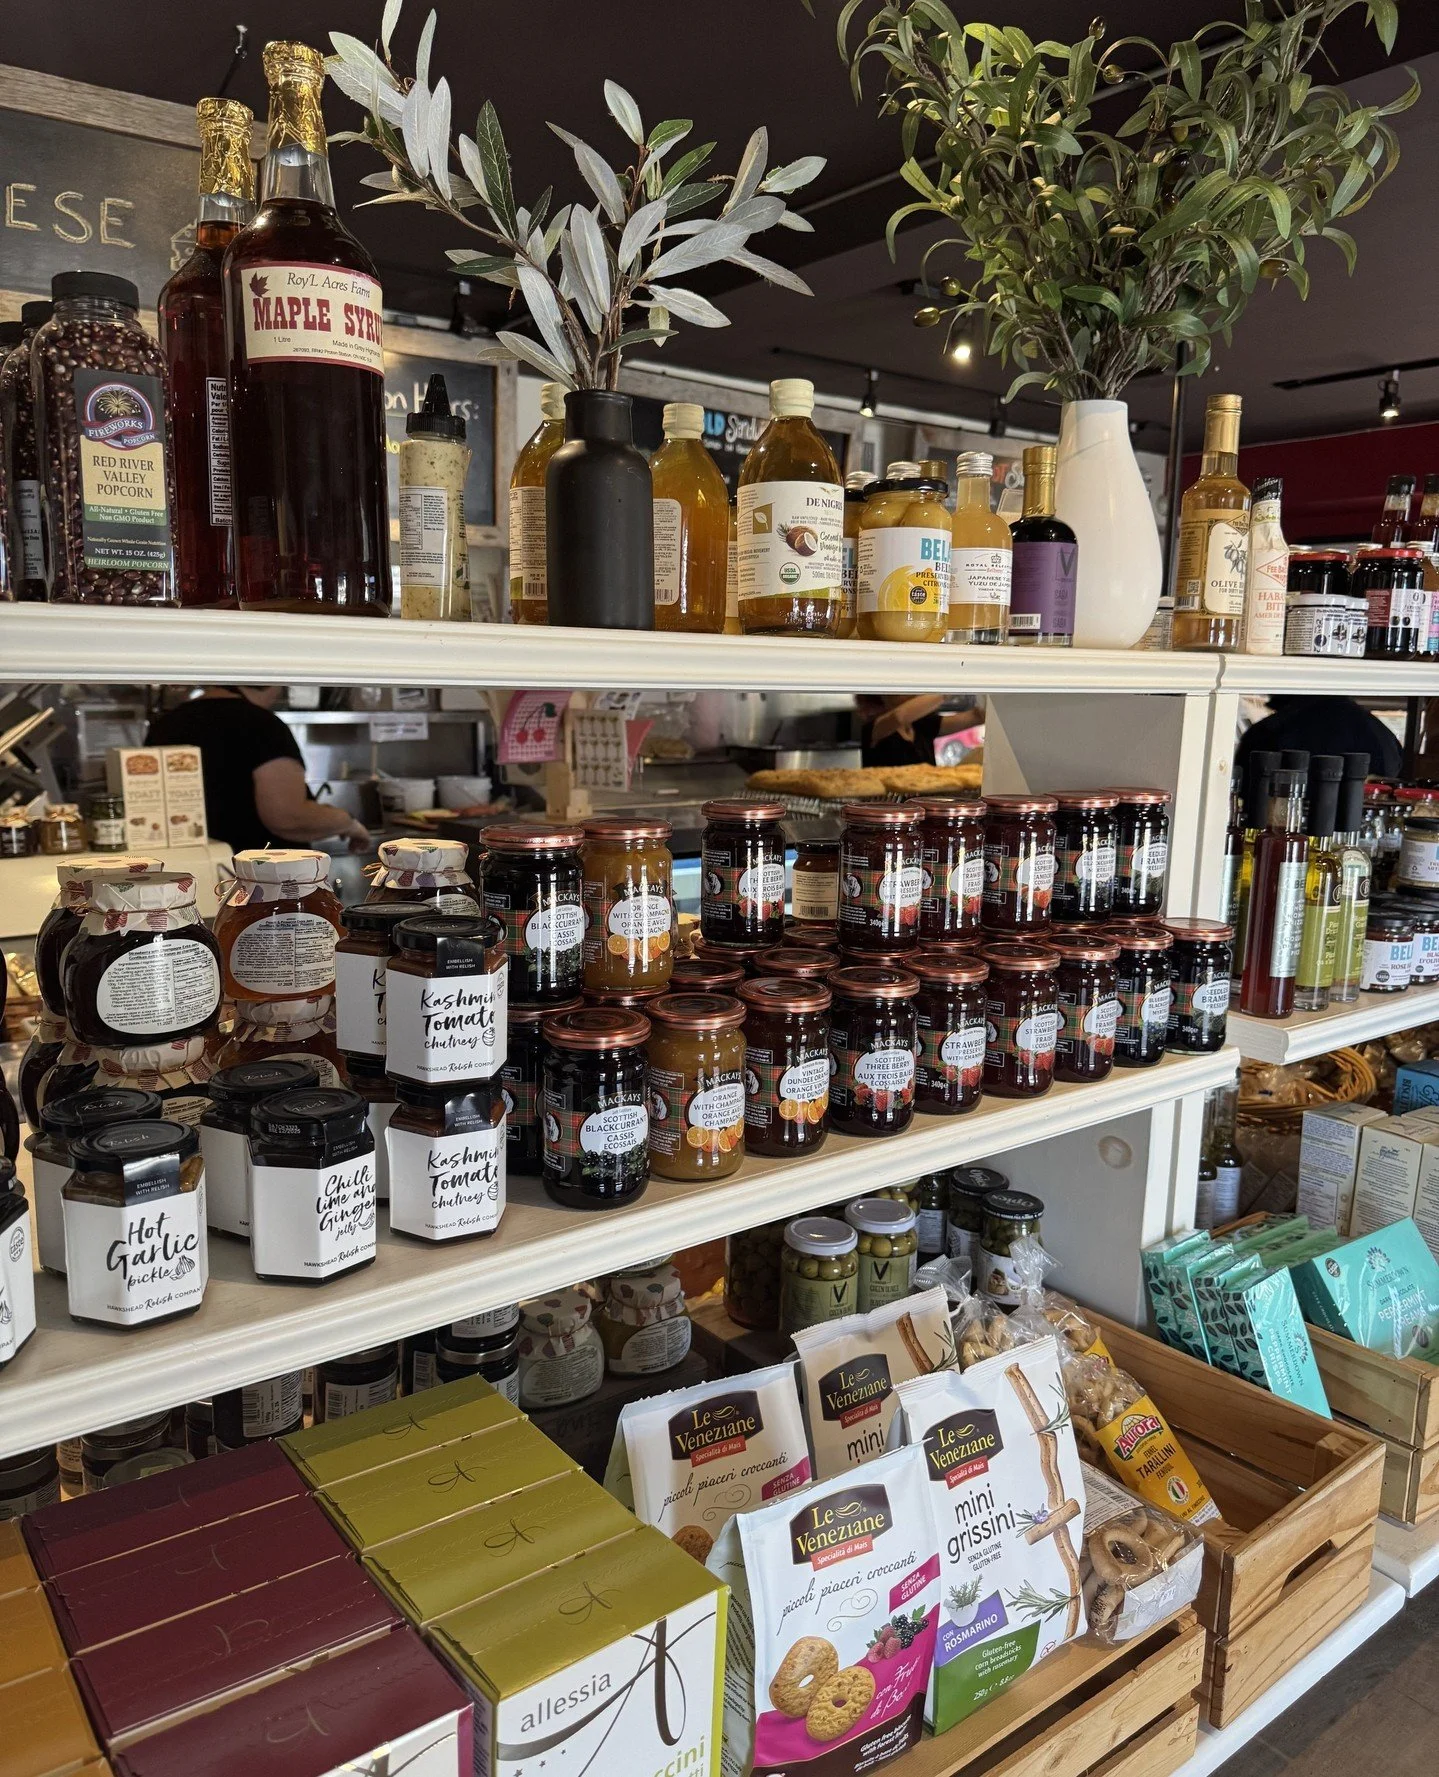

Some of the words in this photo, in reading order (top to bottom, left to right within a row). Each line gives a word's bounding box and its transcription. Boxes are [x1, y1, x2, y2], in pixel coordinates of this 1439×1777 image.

[322, 276, 348, 291] Acres
[253, 297, 331, 332] MAPLE
[88, 420, 143, 437] FIREWORKS
[123, 433, 155, 444] POPCORN
[93, 455, 116, 468] RED
[120, 458, 155, 471] RIVER
[103, 470, 146, 484] VALLEY
[97, 484, 153, 498] POPCORN
[806, 497, 820, 507] DE
[89, 506, 122, 514] All-Natural
[151, 510, 163, 518] Free
[132, 516, 155, 524] Product
[95, 547, 110, 555] NET
[88, 558, 130, 568] HEIRLOOM
[132, 560, 169, 569] POPCORN
[1266, 565, 1277, 573] FEE
[1211, 580, 1237, 589] OLIVE
[424, 1034, 480, 1050] chutney
[870, 1039, 909, 1050] MACKAYS
[416, 1064, 448, 1072] HAWKSHEAD
[448, 1060, 473, 1073] Relish
[875, 1056, 905, 1064] SCOTTISH
[891, 1061, 910, 1069] BERRY
[787, 1076, 813, 1085] DUNDEE
[858, 1072, 875, 1080] AUX
[870, 1078, 906, 1087] ECOSSAISES
[712, 1091, 737, 1102] ORANGE
[786, 1086, 813, 1094] ORANGE
[597, 1093, 641, 1109] MACKAYS
[603, 1112, 638, 1123] SCOTTISH
[702, 1111, 730, 1119] ORANGE
[604, 1138, 637, 1150] ECOSSAIS
[607, 1131, 634, 1142] CASSIS
[135, 1187, 150, 1196] WITH
[151, 1183, 170, 1193] RELISH
[136, 1178, 167, 1189] EMBELLISH
[325, 1165, 373, 1197] Chilli
[316, 1193, 350, 1214] lime
[431, 1192, 485, 1209] chutney
[128, 1212, 171, 1246] Hot
[335, 1221, 357, 1241] jelly
[425, 1222, 457, 1230] HAWKSHEAD
[457, 1215, 481, 1228] Relish
[106, 1233, 199, 1279] Garlic
[304, 1257, 338, 1267] HAWKSHEAD
[338, 1246, 359, 1262] Relish
[127, 1266, 173, 1292] pickle
[107, 1303, 144, 1313] HAWKSHEAD
[145, 1292, 173, 1311] Relish
[1267, 1345, 1283, 1385] CRISPS
[1268, 1327, 1293, 1395] PEPPERMINT
[839, 1371, 855, 1390] Le
[826, 1377, 887, 1411] Veneziane
[691, 1409, 711, 1430] Le
[675, 1416, 756, 1453] Veneziane
[847, 1422, 885, 1461] mini
[938, 1428, 956, 1448] Le
[1116, 1415, 1161, 1458] Aurora
[695, 1447, 722, 1462] Specialità
[722, 1444, 728, 1453] di
[728, 1441, 741, 1451] Mais
[929, 1432, 996, 1470] Veneziane
[1144, 1445, 1158, 1459] FENNEL
[1136, 1443, 1176, 1479] TARALLINI
[773, 1473, 795, 1489] SENZA
[949, 1470, 968, 1484] Specialità
[968, 1466, 974, 1475] di
[973, 1462, 985, 1472] Mais
[658, 1472, 694, 1521] piccoli
[693, 1468, 736, 1507] piaceri
[741, 1451, 788, 1478] croccanti
[773, 1477, 800, 1496] GLUTINE
[955, 1483, 995, 1525] mini
[812, 1506, 835, 1529] Le
[796, 1513, 885, 1556] Veneziane
[947, 1502, 1016, 1564] grissini
[817, 1547, 846, 1565] Specialità
[846, 1544, 853, 1555] di
[853, 1541, 868, 1552] Mais
[967, 1552, 983, 1564] SENZA
[983, 1541, 1002, 1556] GLUTINE
[972, 1552, 1002, 1572] GLUTEN-FREE
[900, 1571, 921, 1593] SENZA
[901, 1575, 926, 1600] GLUTINE
[776, 1577, 816, 1636] piccoli
[815, 1571, 862, 1615] piaceri
[867, 1550, 917, 1581] croccanti
[942, 1630, 954, 1641] CON
[944, 1613, 998, 1652] ROSMARINO
[975, 1661, 989, 1671] corn
[989, 1645, 1022, 1664] breadsticks
[982, 1640, 1016, 1658] Gluten-free
[977, 1668, 992, 1678] with
[992, 1655, 1018, 1671] rosemary
[520, 1672, 612, 1733] allessia
[860, 1737, 880, 1752] Gluten
[881, 1731, 894, 1742] free
[863, 1746, 876, 1757] with
